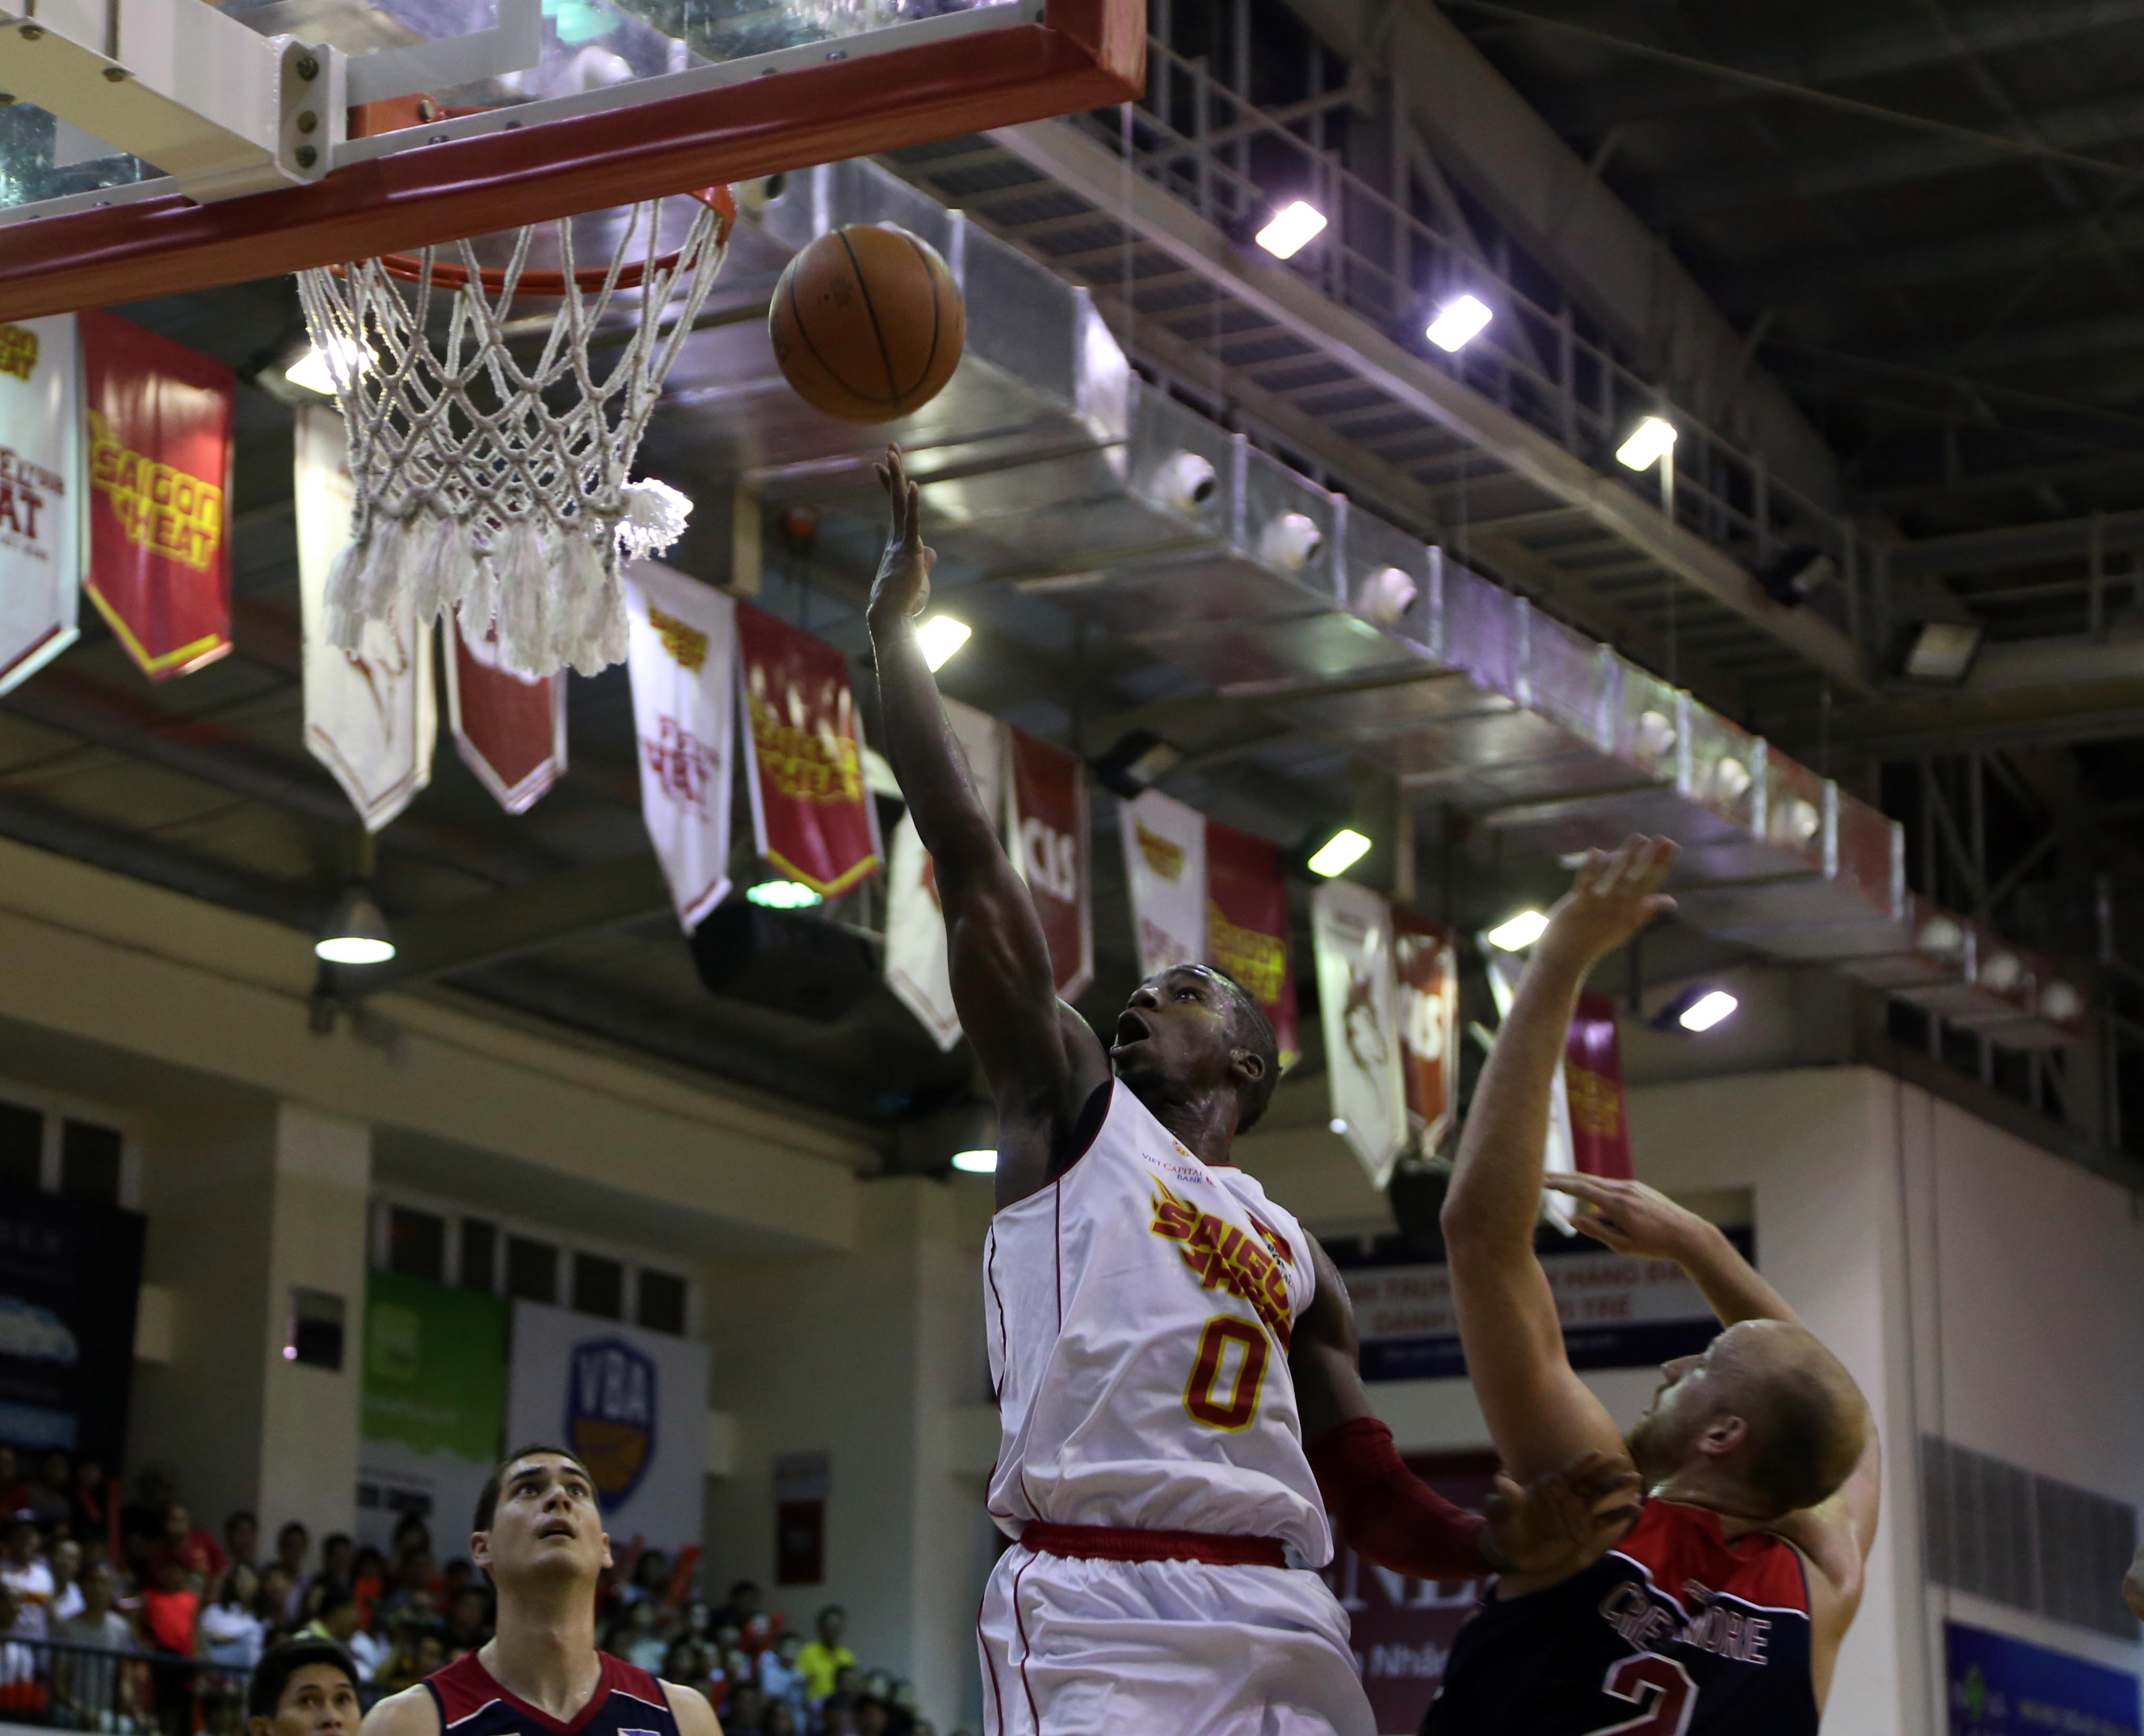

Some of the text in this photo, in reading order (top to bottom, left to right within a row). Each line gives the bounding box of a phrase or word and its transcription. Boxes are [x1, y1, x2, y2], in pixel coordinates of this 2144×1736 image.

[1177, 1174, 1202, 1183] BANK
[1149, 1198, 1291, 1314] SAIGO
[1182, 1314, 1271, 1433] 0
[1575, 1651, 1700, 1736] 2
